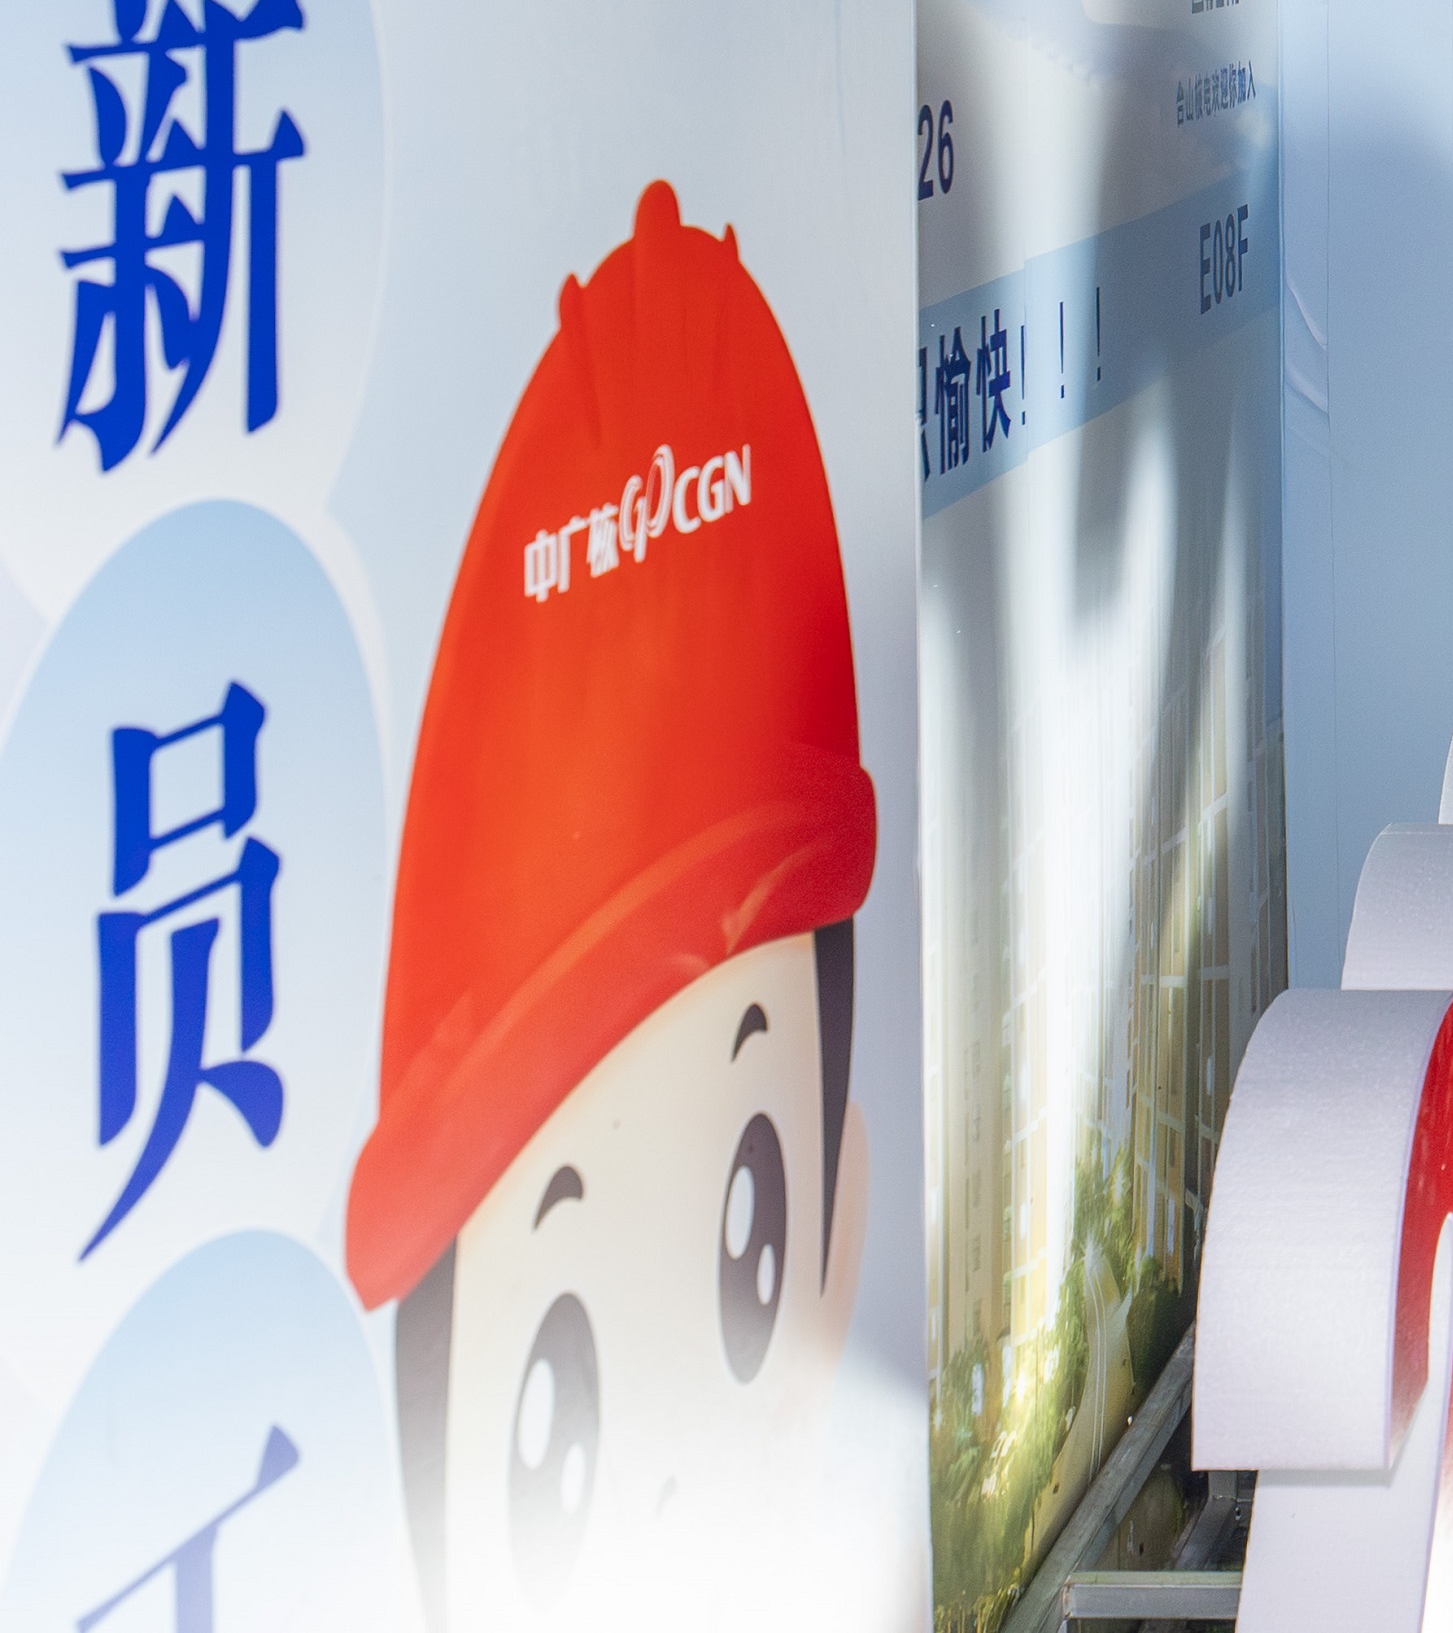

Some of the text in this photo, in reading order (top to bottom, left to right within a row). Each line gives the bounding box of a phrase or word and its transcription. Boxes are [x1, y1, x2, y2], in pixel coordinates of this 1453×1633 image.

[917, 99, 954, 201] 26
[1200, 204, 1248, 315] E08F
[524, 443, 752, 603] 中广核 CGN
